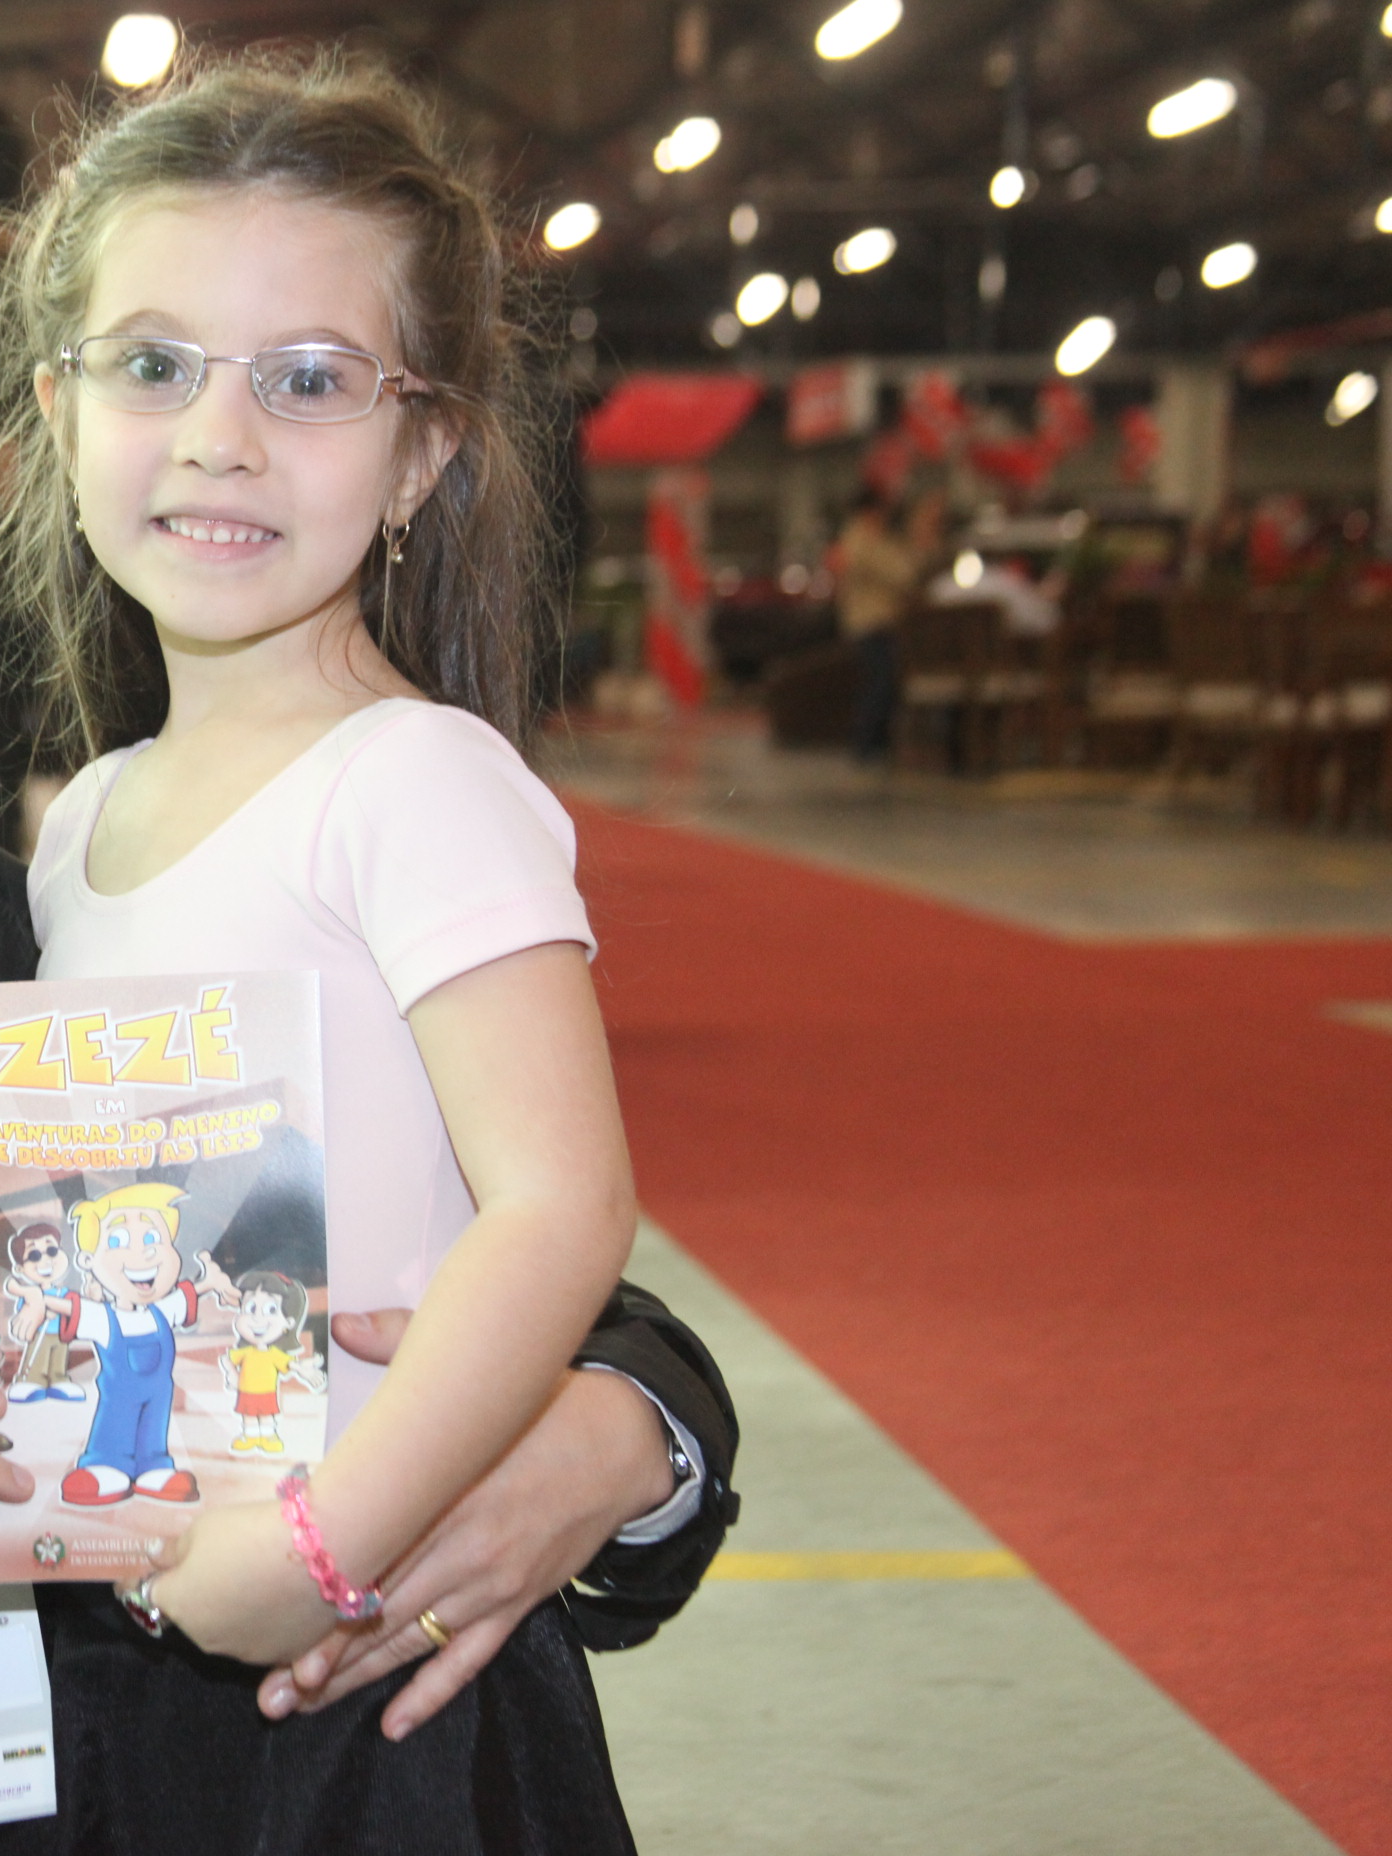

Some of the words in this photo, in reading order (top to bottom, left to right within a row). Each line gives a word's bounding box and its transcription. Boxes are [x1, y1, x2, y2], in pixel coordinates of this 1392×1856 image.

[95, 1098, 126, 1114] EM
[127, 1120, 163, 1143] DO
[171, 1103, 279, 1139] MENINO
[17, 1143, 152, 1170] DESCOBRIU
[159, 1139, 196, 1165] AS
